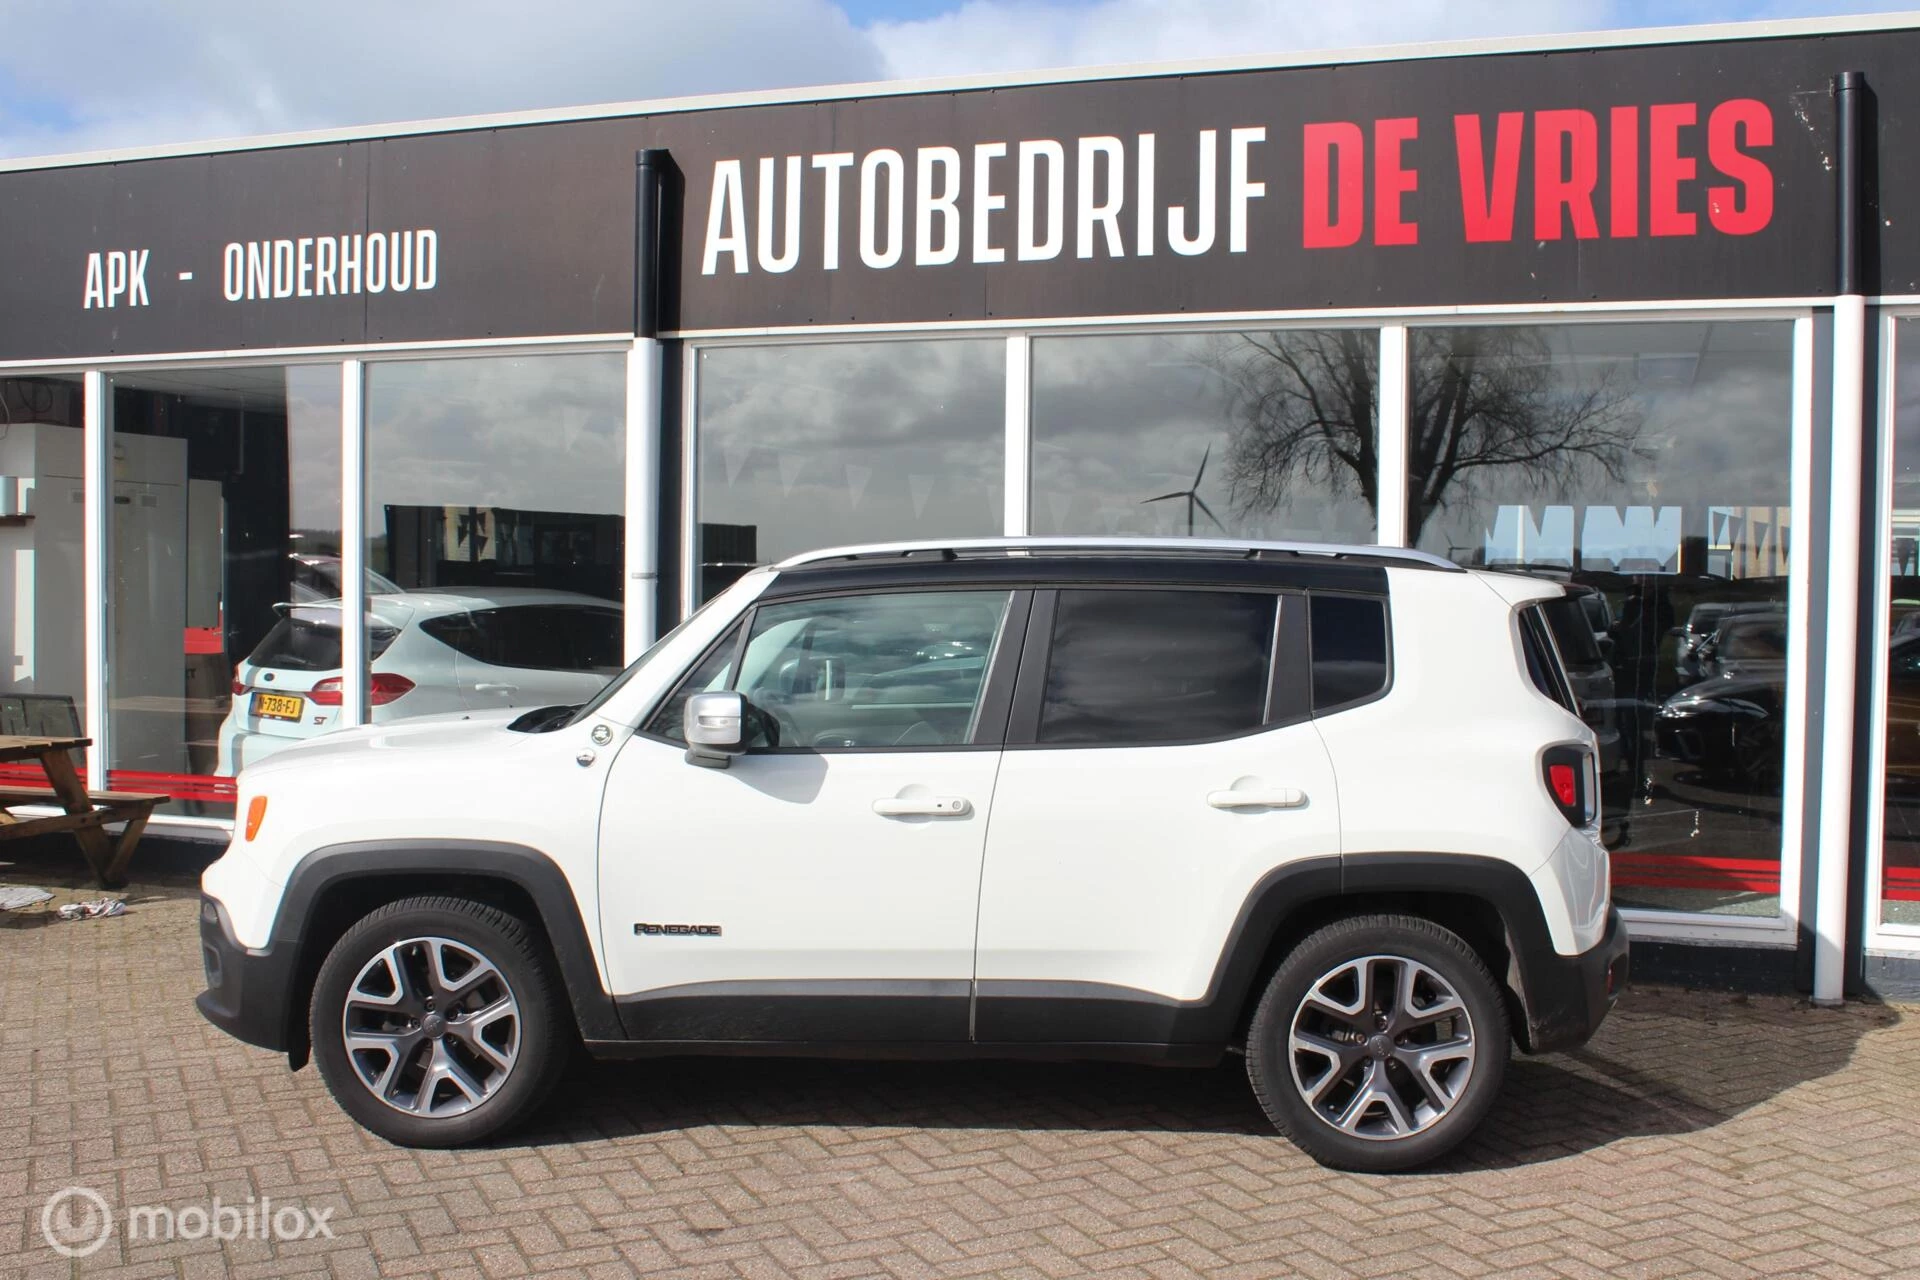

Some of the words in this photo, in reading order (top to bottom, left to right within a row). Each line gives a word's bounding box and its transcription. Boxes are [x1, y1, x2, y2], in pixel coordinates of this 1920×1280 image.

[702, 126, 1267, 275] AUTOBEDRIJF
[1303, 117, 1418, 248] DE
[1454, 98, 1774, 243] VRIES
[83, 249, 150, 309] APK
[223, 229, 437, 302] ONDERHOUD
[313, 716, 328, 726] ST
[633, 922, 723, 937] RENEGADE
